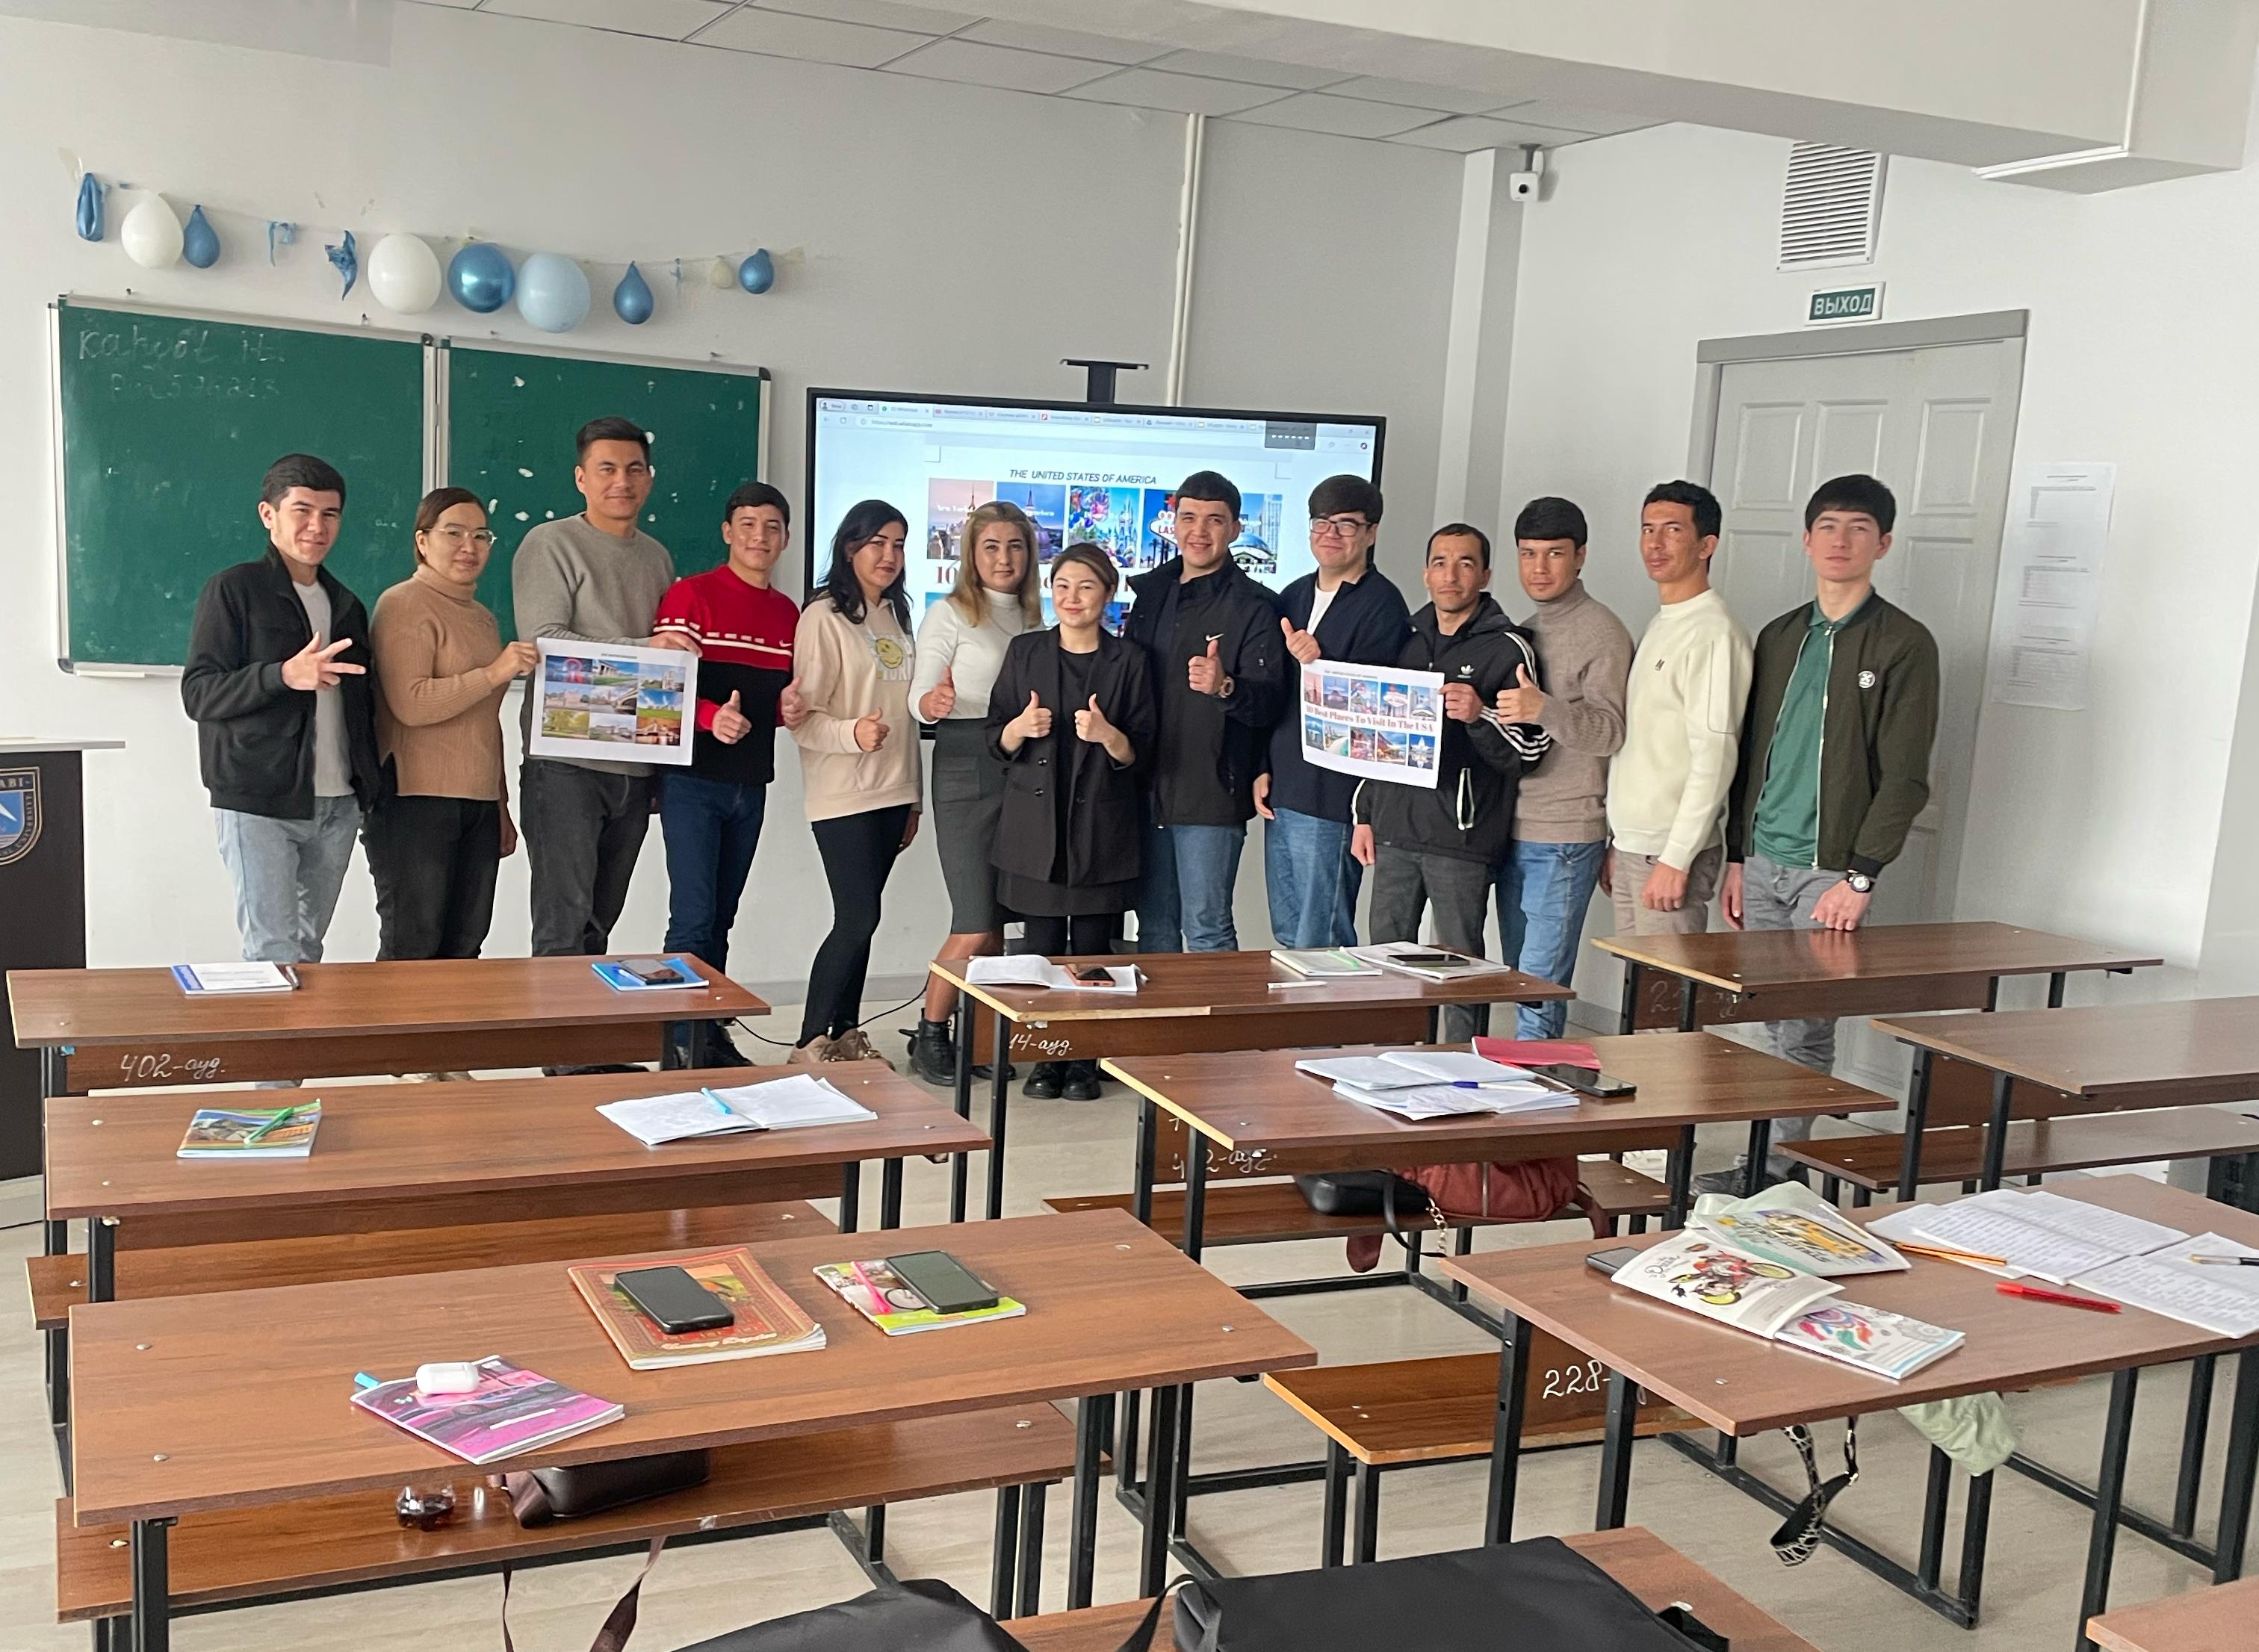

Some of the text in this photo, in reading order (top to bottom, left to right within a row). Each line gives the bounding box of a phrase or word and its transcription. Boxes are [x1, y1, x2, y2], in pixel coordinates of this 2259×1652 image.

[1814, 294, 1873, 315] ВЫХОД
[1009, 469, 1156, 485] THE UNITED STATES OF AMERICA
[1314, 706, 1327, 718] Best
[1330, 711, 1354, 723] Places
[1355, 715, 1366, 724] To
[1366, 716, 1386, 727] Visit
[1398, 720, 1414, 730] The
